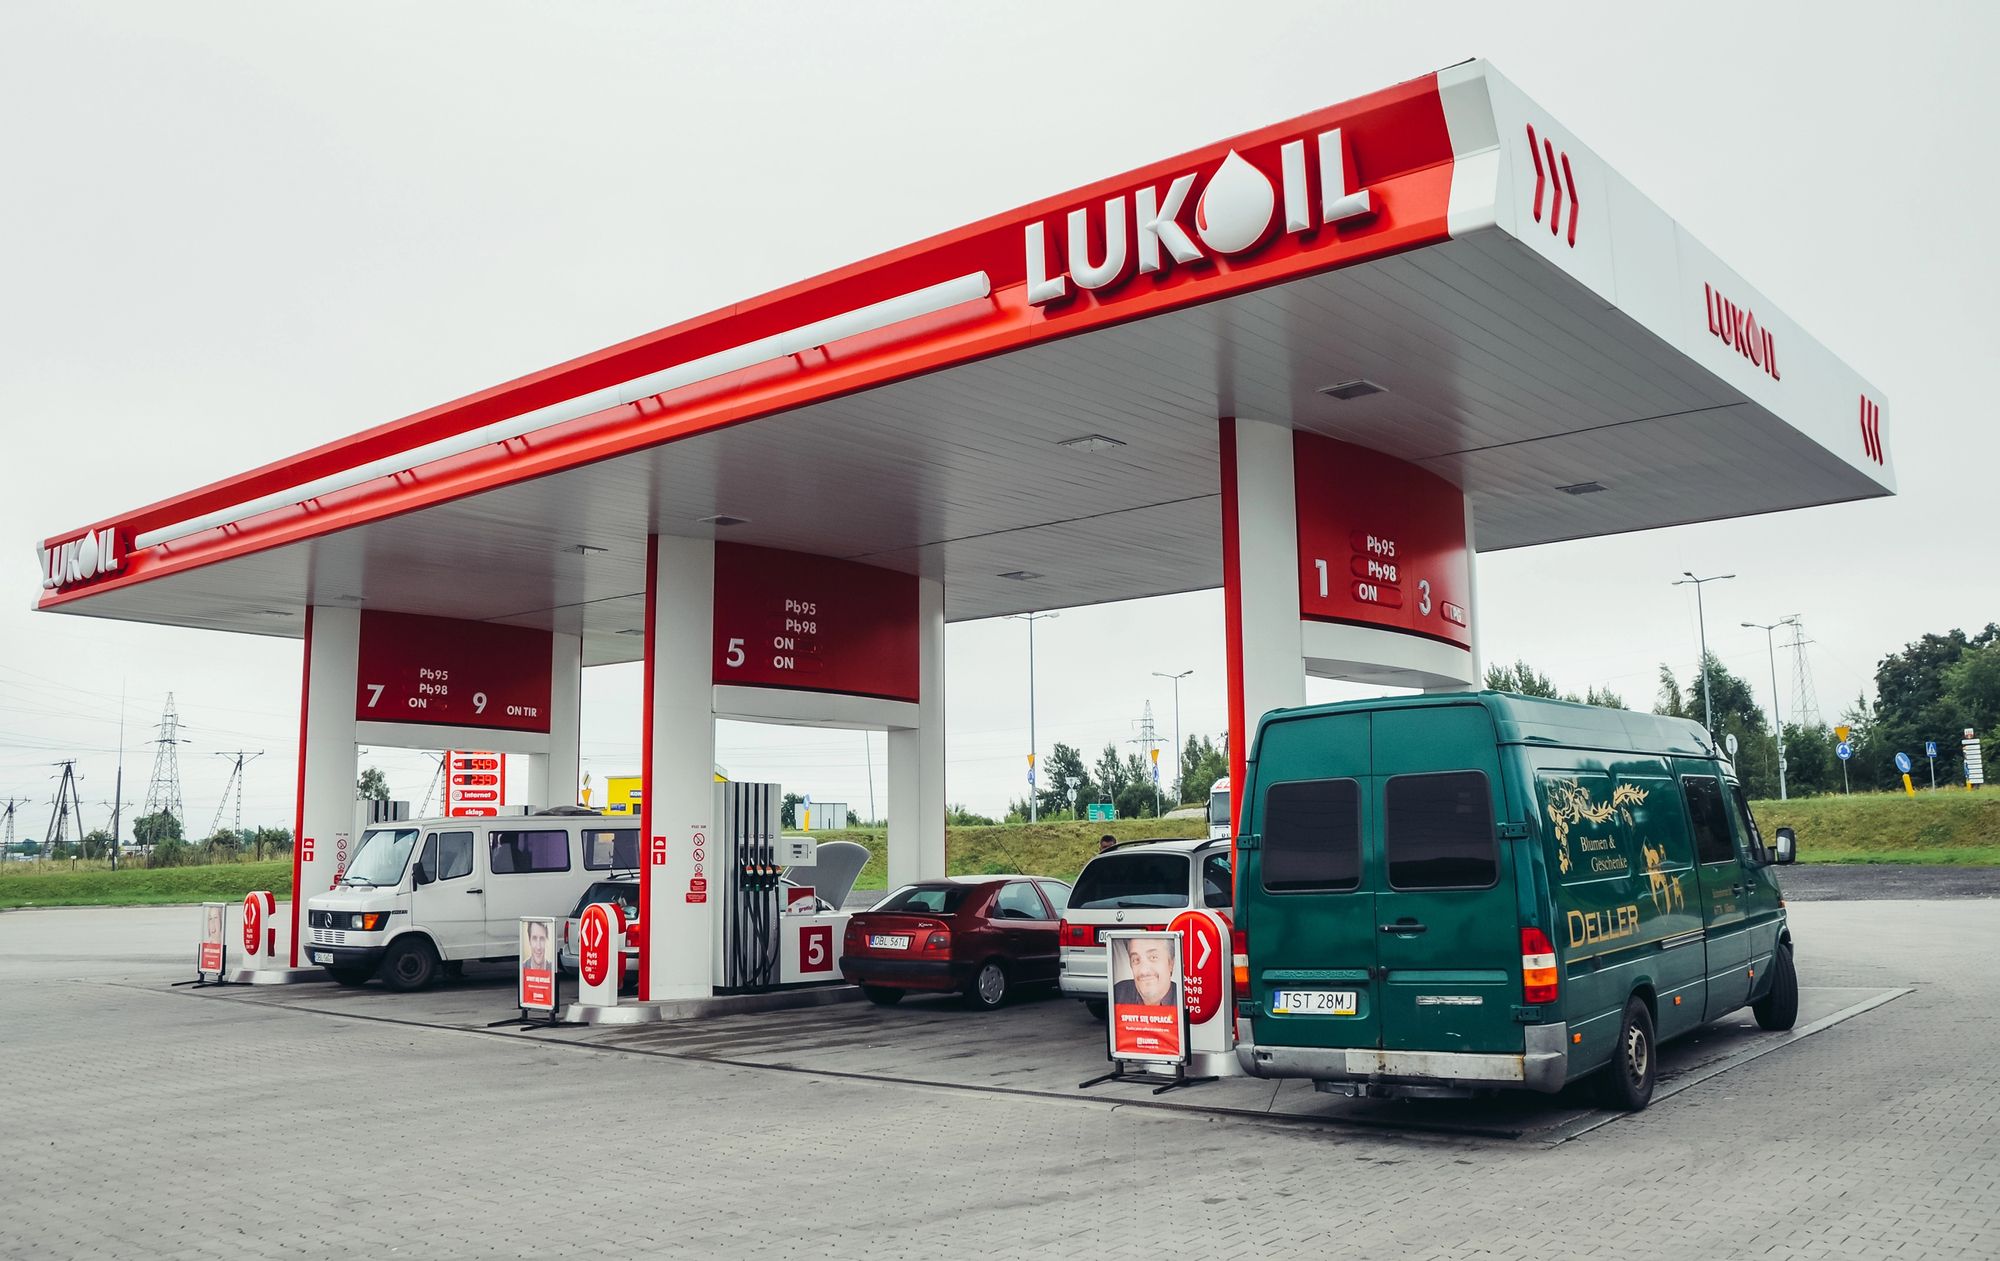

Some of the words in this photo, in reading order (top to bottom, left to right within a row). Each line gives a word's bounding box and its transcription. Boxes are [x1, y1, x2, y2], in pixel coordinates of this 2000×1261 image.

[1025, 127, 1371, 306] LUKOIL
[1704, 280, 1781, 382] LUKOIL
[1366, 534, 1395, 557] Pb95
[42, 526, 118, 590] LUKOIL
[1315, 558, 1329, 598] 1
[1367, 560, 1397, 582] Pb98
[1358, 583, 1378, 602] ON
[1418, 579, 1432, 616] 3
[785, 599, 817, 616] Pb95
[785, 619, 817, 635] Pb98
[773, 636, 794, 650] ON
[726, 638, 746, 668] 5
[773, 656, 794, 669] ON
[419, 667, 449, 681] Pb95
[367, 684, 386, 708] 7
[419, 683, 448, 696] Pb98
[408, 697, 428, 709] ON
[472, 692, 488, 714] 9
[506, 705, 522, 716] ON
[524, 706, 537, 718] TIR
[465, 808, 483, 817] sklep
[1580, 836, 1609, 852] Blumen
[1609, 834, 1616, 849] &
[1591, 854, 1628, 873] Geschenke
[1567, 904, 1640, 947] DELLER
[808, 934, 825, 966] 5
[875, 937, 887, 946] DBL
[889, 938, 905, 948] 56TL
[1187, 996, 1200, 1005] ON
[1283, 993, 1312, 1009] TST
[1317, 994, 1353, 1009] 28MJ
